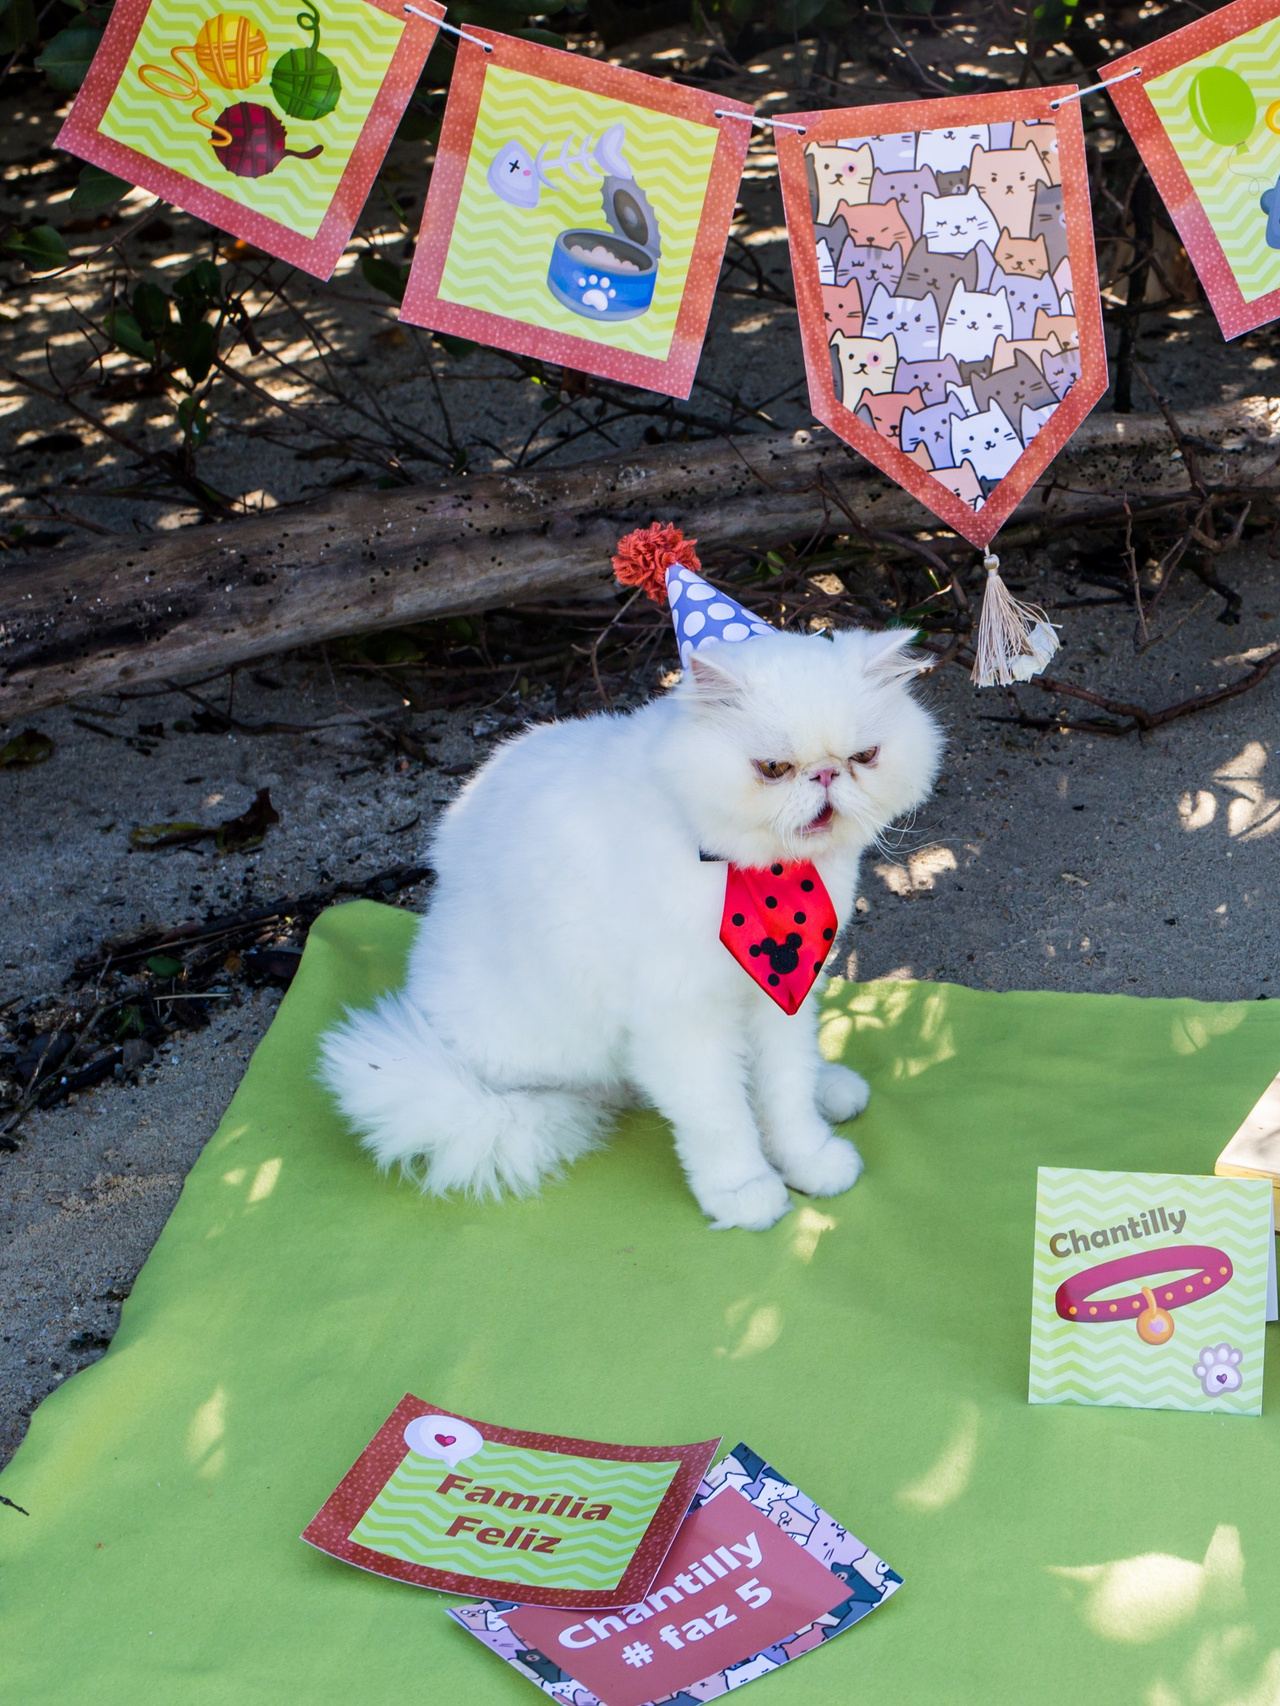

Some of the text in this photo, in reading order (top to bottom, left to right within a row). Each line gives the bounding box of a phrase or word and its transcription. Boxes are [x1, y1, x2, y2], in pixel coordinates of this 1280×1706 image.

[1049, 1206, 1187, 1259] Chantilly
[435, 1473, 613, 1521] Família
[444, 1515, 563, 1554] Feliz
[558, 1531, 763, 1649] Chantilly
[621, 1577, 773, 1669] # faz 5
